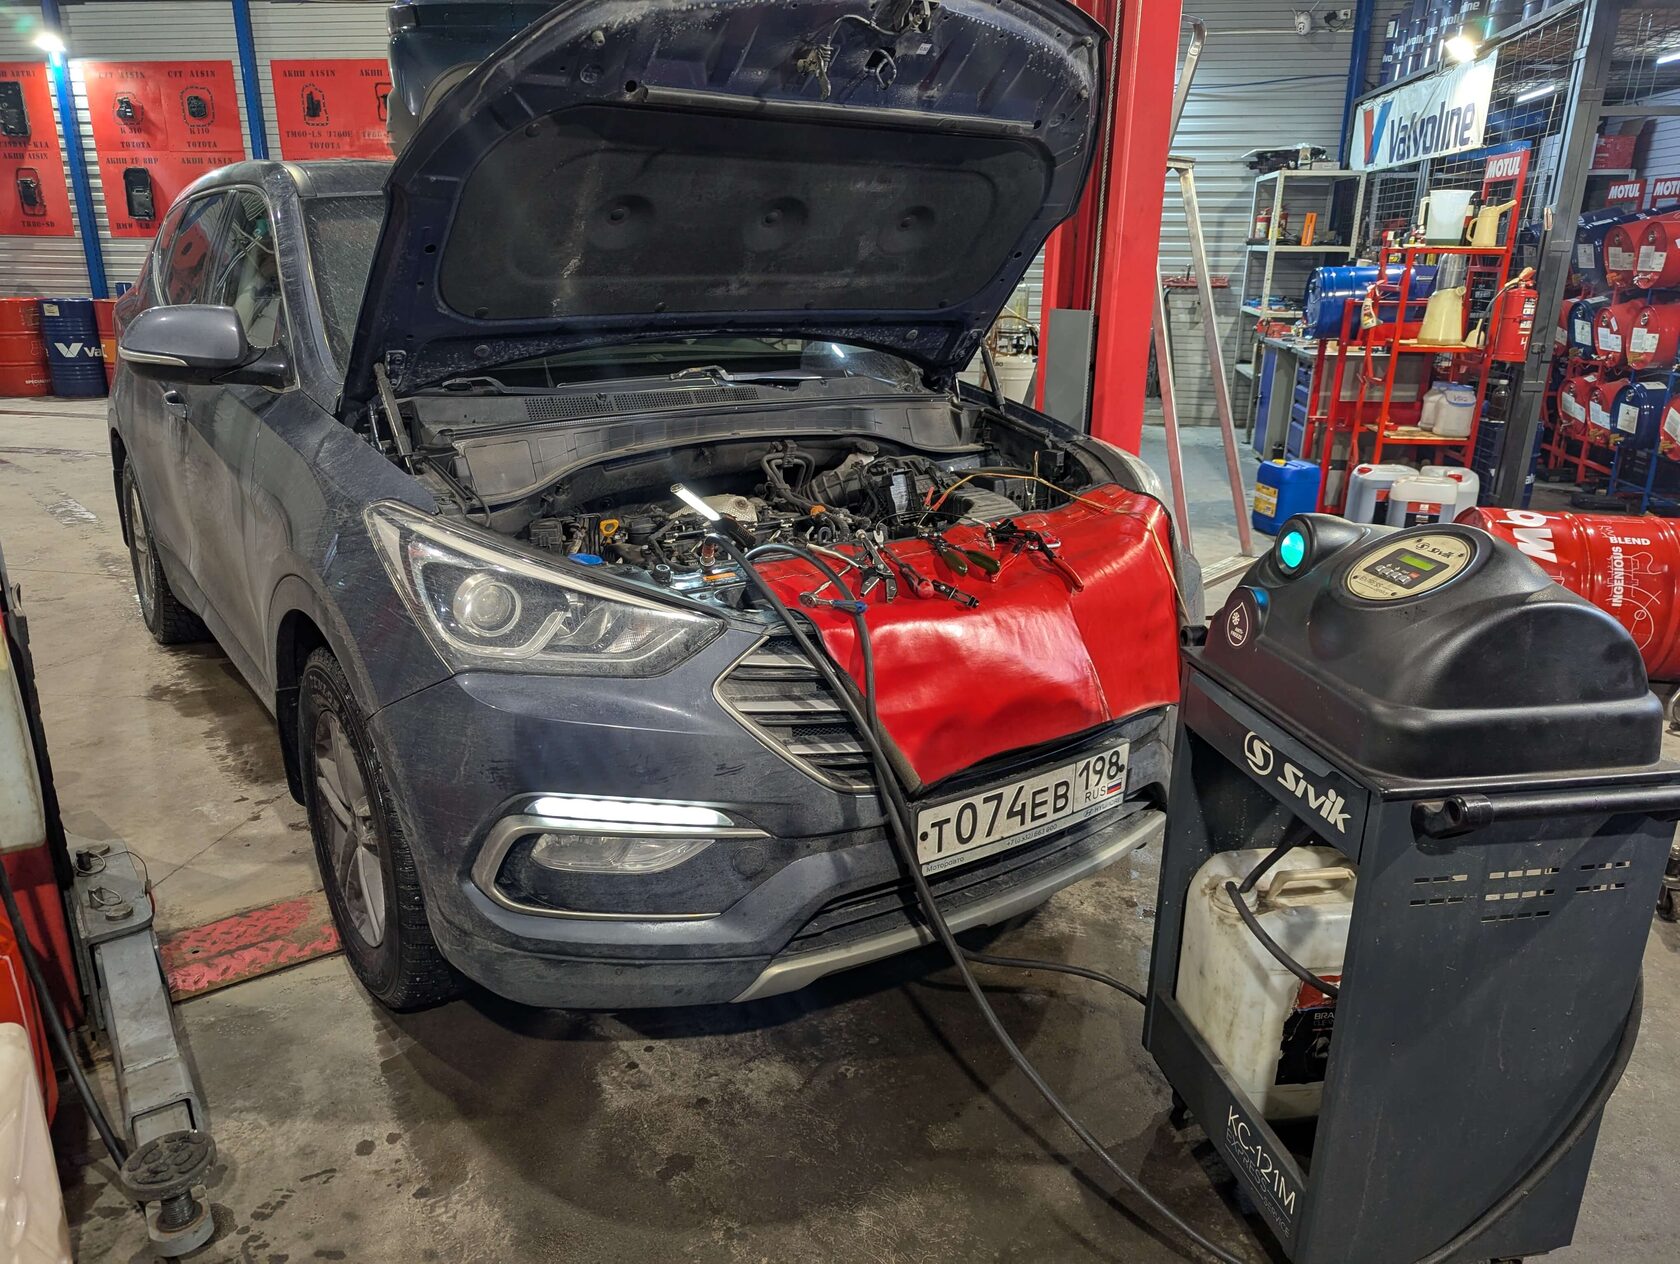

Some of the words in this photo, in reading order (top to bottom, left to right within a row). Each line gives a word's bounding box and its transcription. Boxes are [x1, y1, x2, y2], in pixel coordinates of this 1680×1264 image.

[189, 70, 216, 78] AISIN
[309, 69, 336, 77] AISIN
[1388, 101, 1475, 164] Valvoline
[1486, 156, 1521, 179] MOTUL
[1608, 183, 1640, 199] MOTUL
[1609, 536, 1651, 546] BLEND
[1611, 546, 1625, 607] INGENIOUS
[1078, 750, 1120, 791] 198
[1084, 785, 1106, 803] RUS
[1276, 762, 1352, 834] Sivik
[1314, 1012, 1335, 1020] BRA
[1225, 1127, 1267, 1193] EXPRESS
[1263, 1196, 1290, 1238] SERVICE
